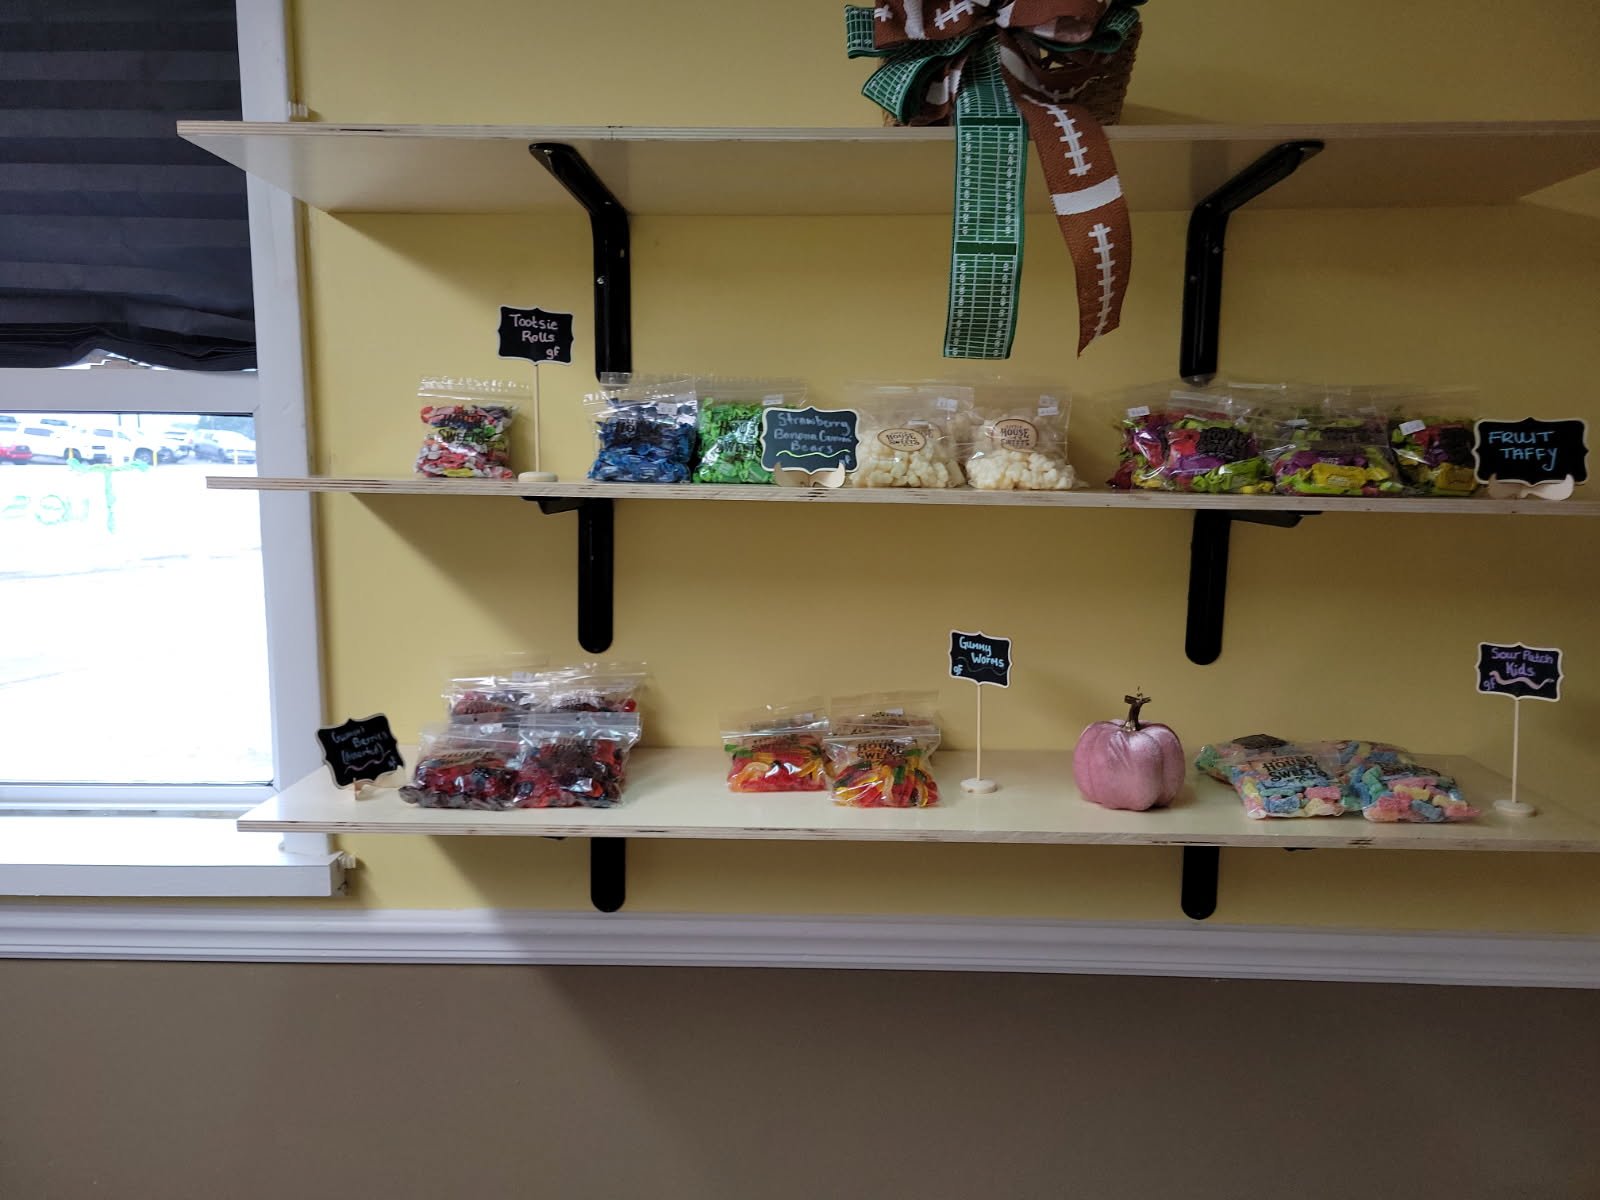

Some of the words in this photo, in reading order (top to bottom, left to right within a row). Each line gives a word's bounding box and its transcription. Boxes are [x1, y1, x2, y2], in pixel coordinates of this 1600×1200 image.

[508, 314, 559, 330] Tootsie
[521, 330, 555, 343] Rolls
[777, 412, 850, 436] Strawberry
[1000, 428, 1029, 438] HOUSE
[1488, 430, 1555, 444] FRUIT
[791, 440, 833, 454] Bears
[1499, 447, 1557, 471] TAFFY
[1491, 647, 1521, 659] Sour
[1522, 650, 1553, 664] Patch
[1506, 662, 1536, 677] Kids
